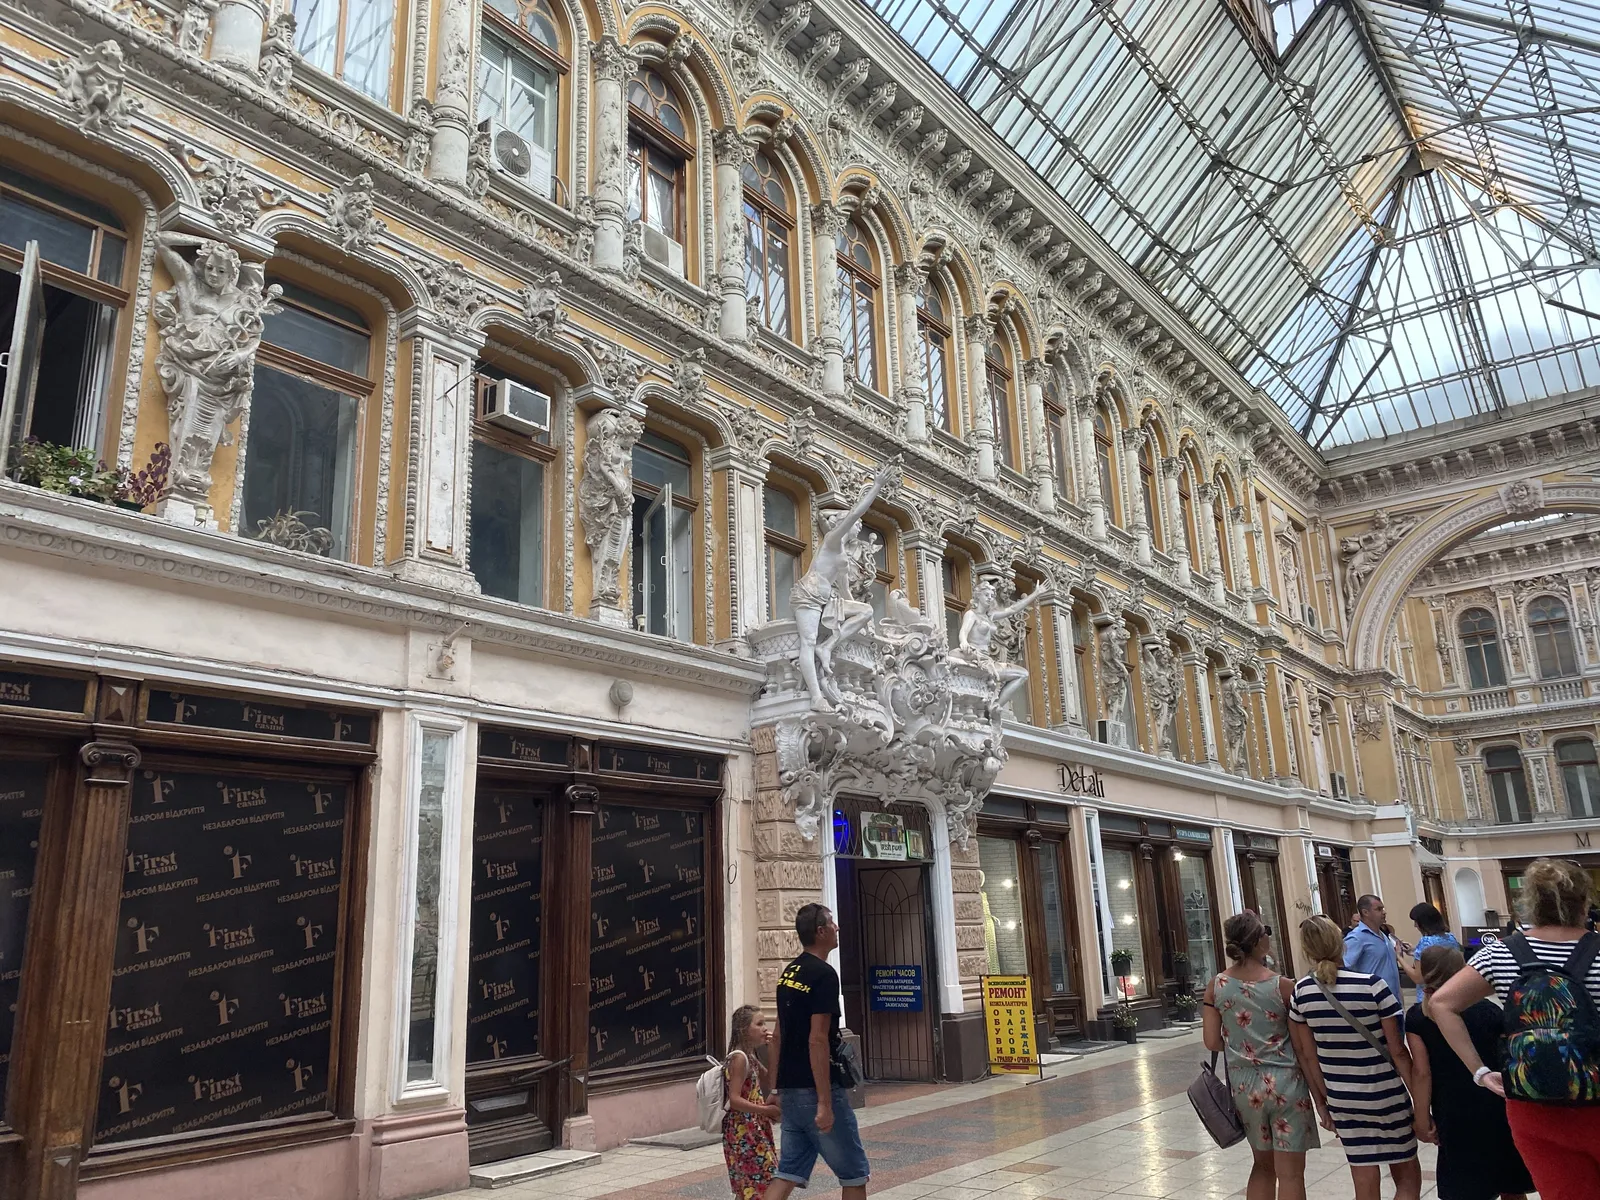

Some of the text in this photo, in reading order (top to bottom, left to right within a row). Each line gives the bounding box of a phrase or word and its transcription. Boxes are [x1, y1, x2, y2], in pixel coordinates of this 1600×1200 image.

[0, 682, 31, 695] rst
[242, 702, 284, 725] First
[254, 722, 285, 731] casino
[511, 738, 540, 757] First
[647, 753, 670, 769] First
[1057, 763, 1105, 798] Detali
[221, 785, 265, 804] First
[236, 799, 266, 808] casino
[130, 812, 164, 824] АБАРОМ
[203, 818, 248, 831] НЕЗАБАРОМ
[635, 813, 659, 828] First
[283, 823, 324, 835] НЕЗАБАРОМ
[127, 850, 176, 873] First
[293, 857, 335, 877] First
[486, 861, 517, 878] First
[143, 865, 178, 876] casino
[308, 870, 336, 880] casino
[677, 866, 700, 881] First
[121, 888, 157, 899] АБАРОМ
[196, 888, 243, 903] НЕЗАБАРОМ
[277, 890, 320, 903] НЕЗАБАРОМ
[635, 917, 659, 934] First
[208, 924, 253, 948] First
[224, 937, 255, 950] casino
[113, 962, 149, 976] АБАРОМ
[188, 962, 236, 977] НЕЗАБАРОМ
[272, 957, 315, 974] НЕЗАБАРОМ
[875, 969, 915, 977] РЕМОНТ ЧАСОВ
[678, 968, 702, 985] First
[483, 978, 515, 1000] First
[989, 987, 1027, 998] РЕМОНТ
[284, 992, 326, 1016] First
[298, 1005, 327, 1018] casino
[109, 1002, 160, 1030] First
[125, 1017, 162, 1031] casino
[265, 1027, 309, 1046] НЕЗАБАРОМ
[634, 1024, 659, 1044] First
[993, 1009, 1003, 1054] ОБУВИ
[1006, 1009, 1016, 1054] ЧАСОВ
[1019, 1009, 1030, 1055] ОДЕЖДЫ
[181, 1033, 230, 1055] НЕЗАБАРОМ
[194, 1072, 241, 1100] First
[209, 1086, 242, 1101] casino
